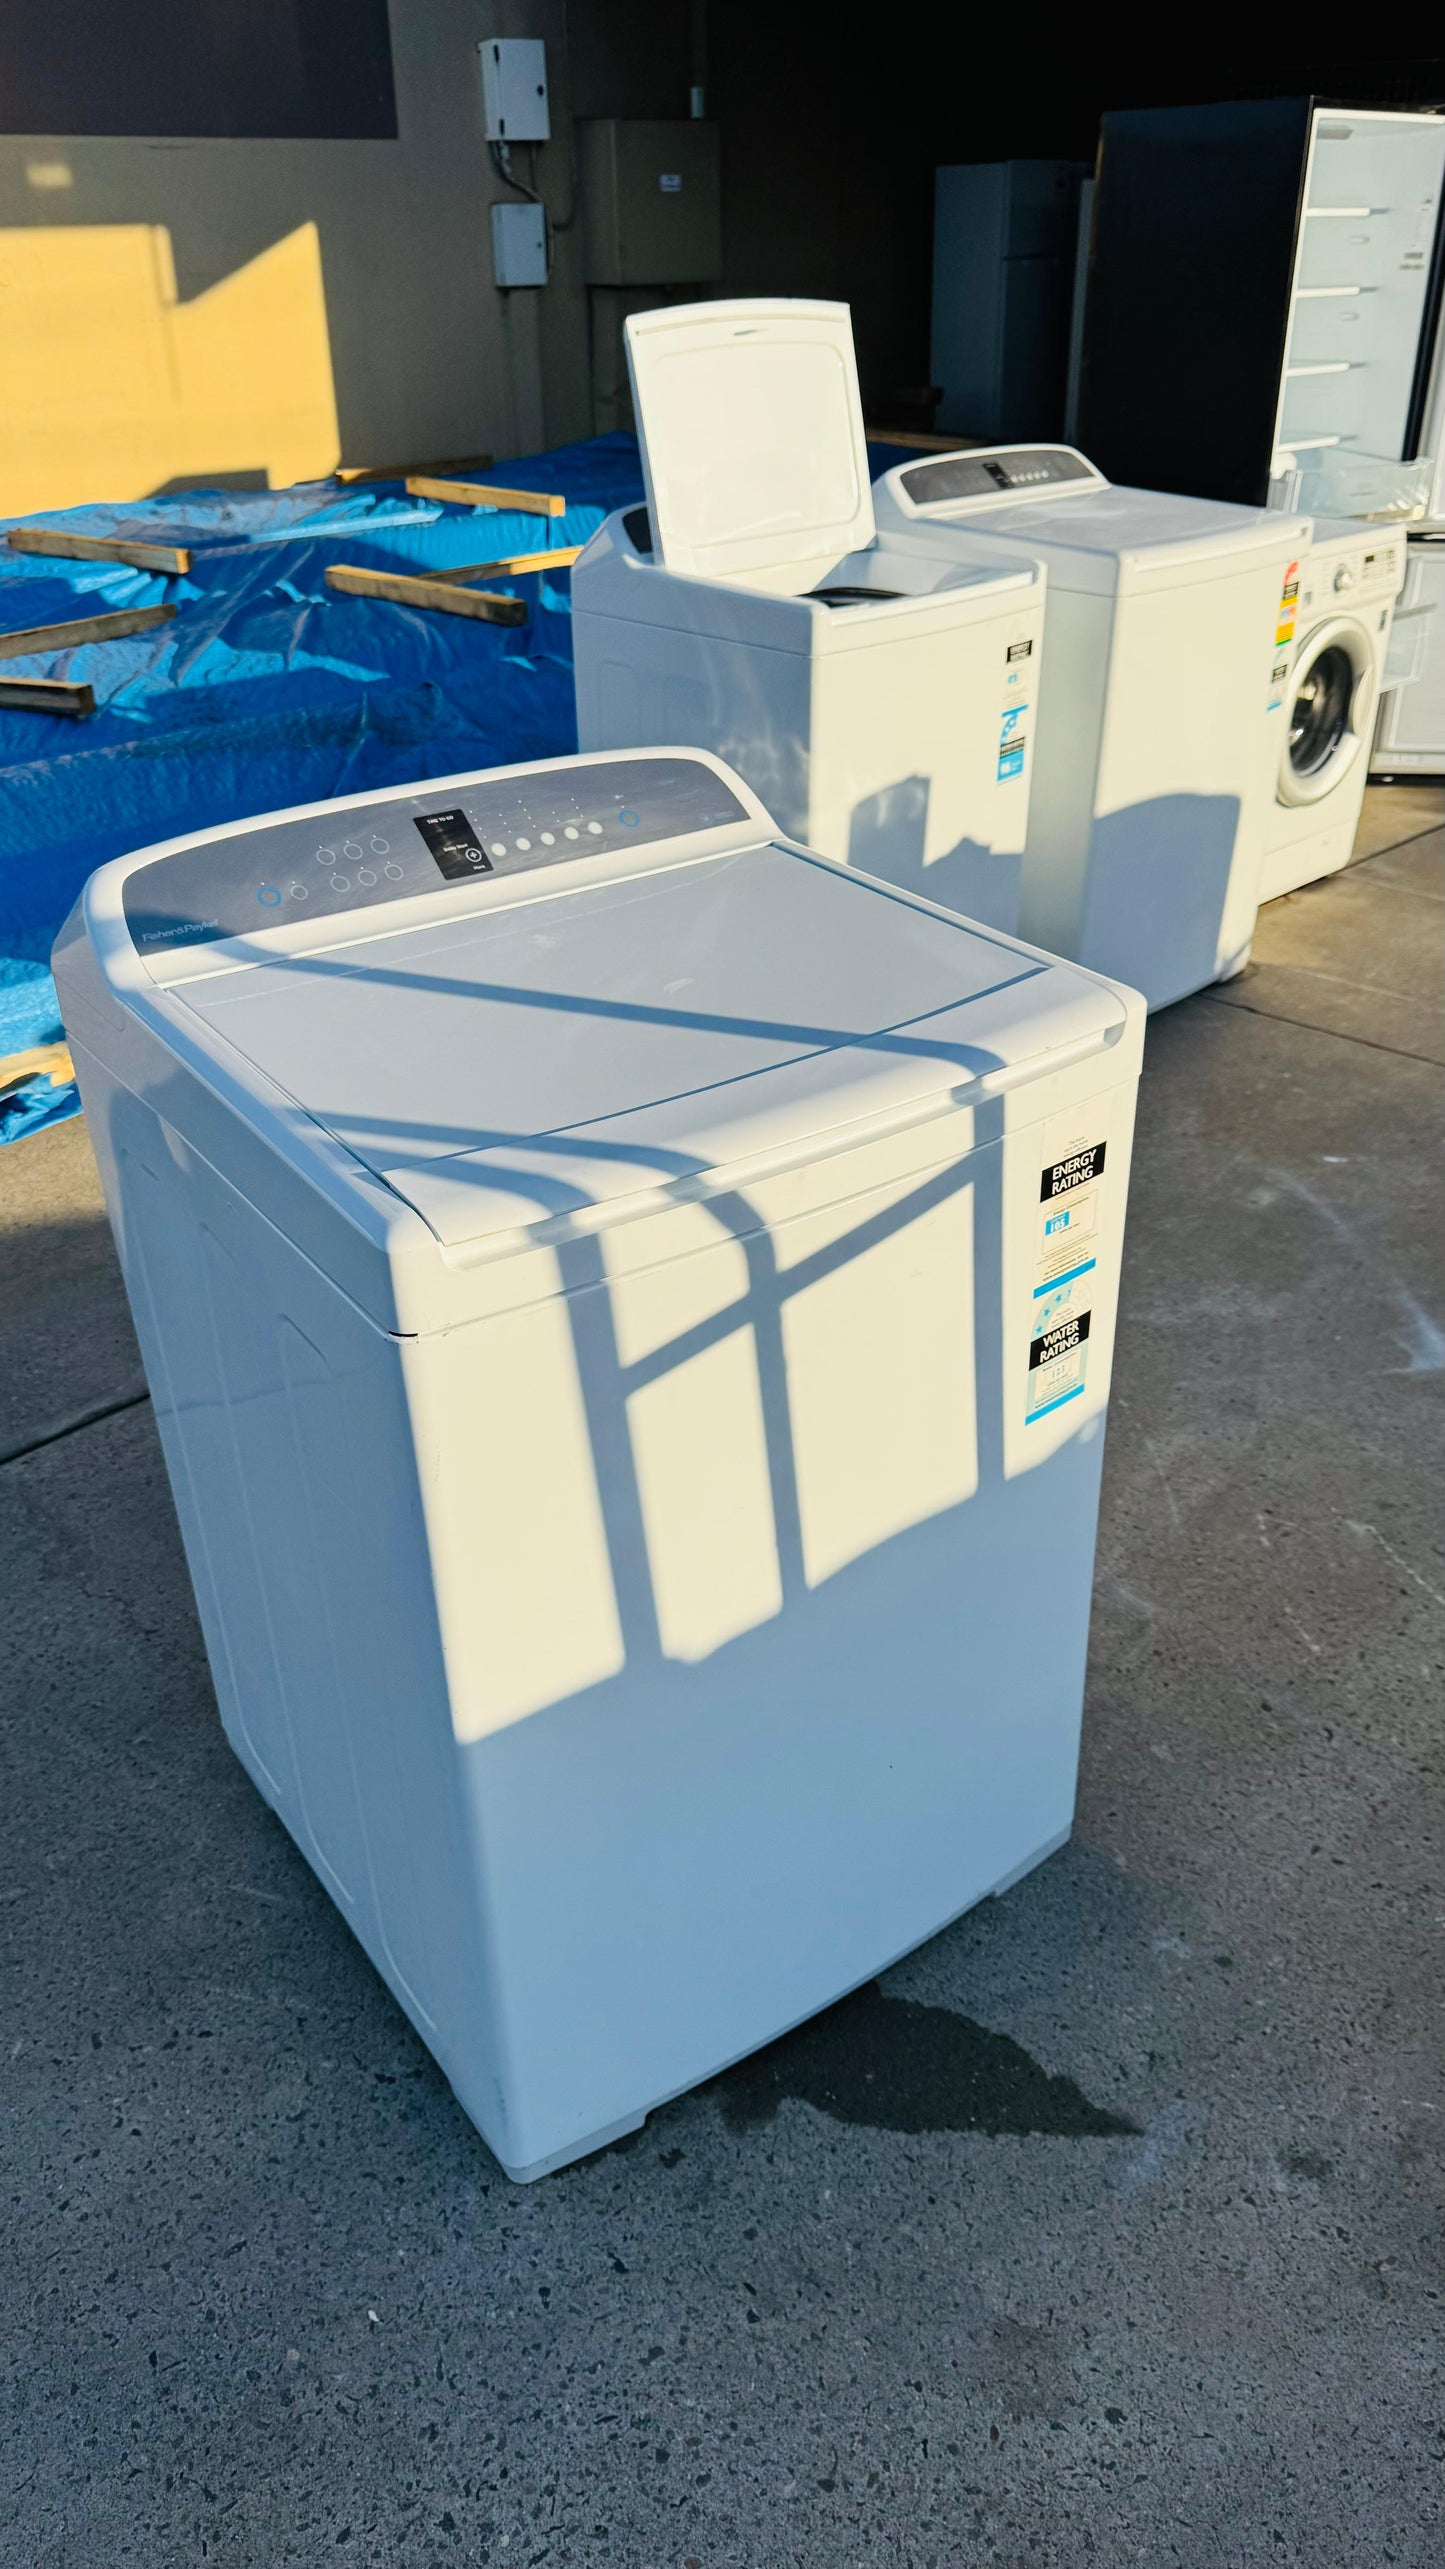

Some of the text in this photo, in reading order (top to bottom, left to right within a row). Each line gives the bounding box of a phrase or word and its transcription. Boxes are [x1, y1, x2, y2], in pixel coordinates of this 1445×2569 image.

[1051, 1165, 1094, 1195] RATING
[1052, 1148, 1097, 1181] ENERGY
[1040, 1332, 1080, 1364] RATING
[1043, 1320, 1080, 1348] WATER
